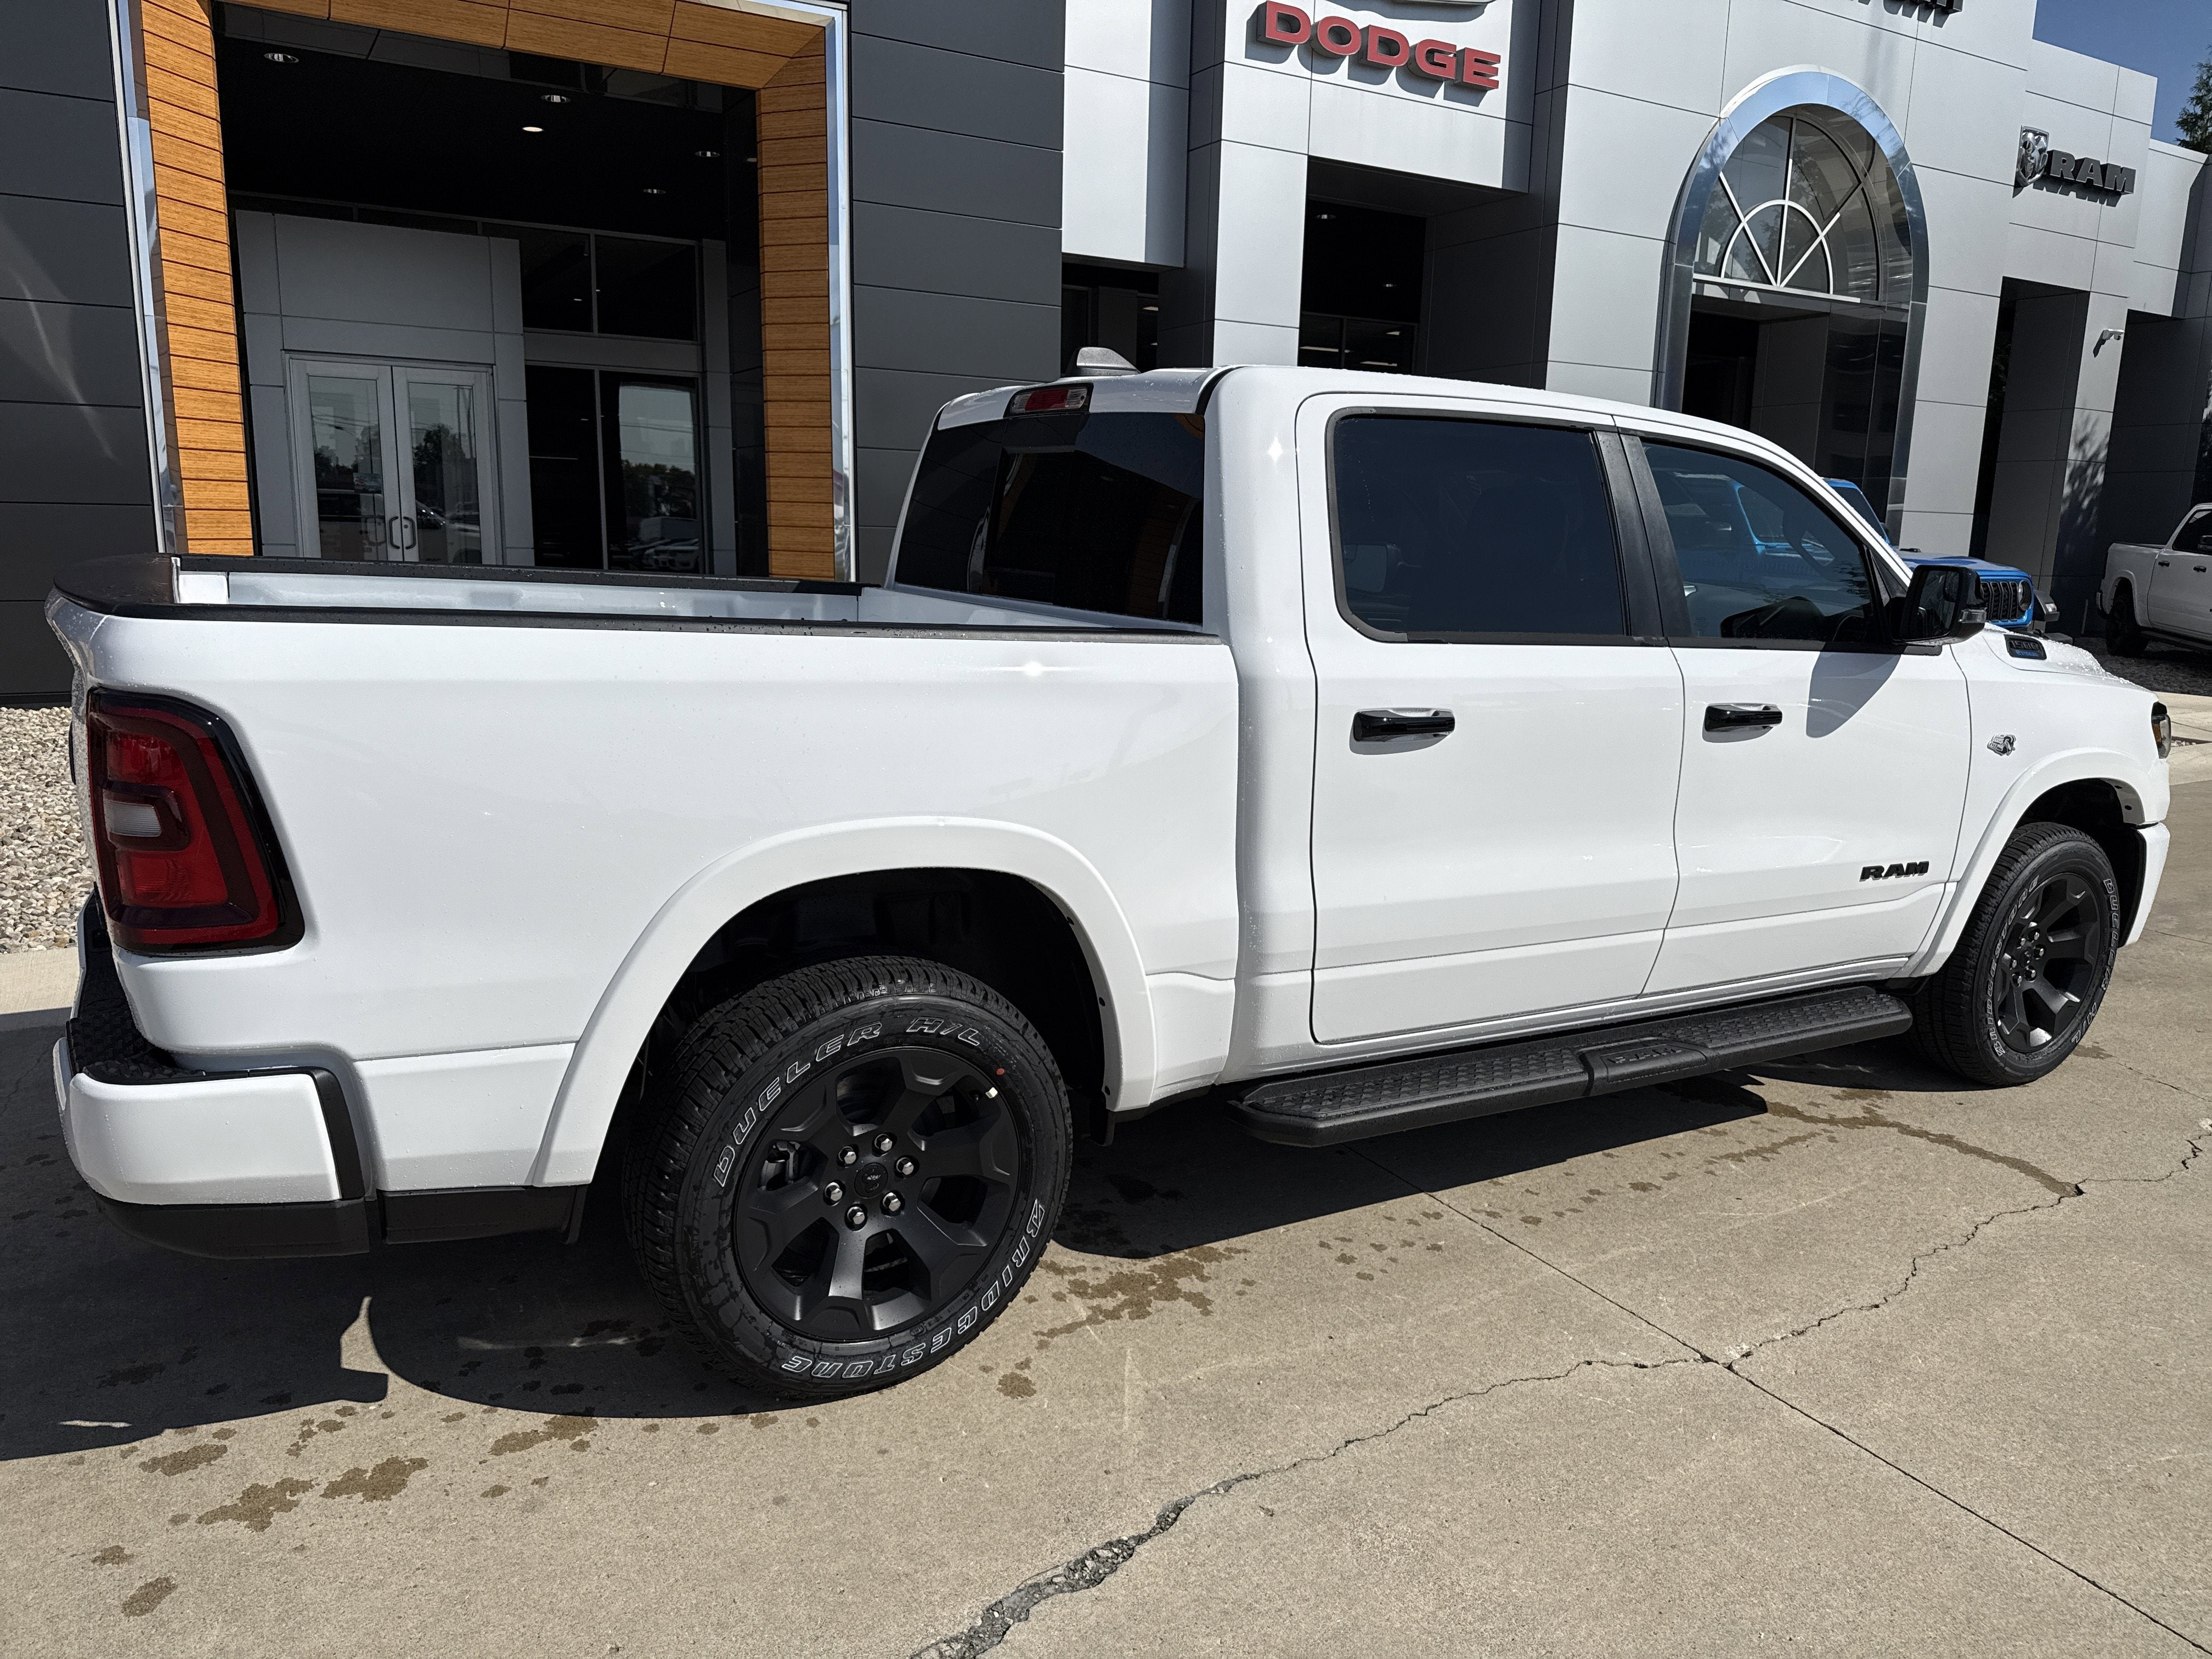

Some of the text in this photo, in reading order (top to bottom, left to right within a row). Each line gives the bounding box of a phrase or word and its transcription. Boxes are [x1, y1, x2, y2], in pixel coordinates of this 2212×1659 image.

[1264, 1, 1501, 89] DODGE
[2050, 149, 2137, 194] RAM
[1859, 861, 1929, 882] RAM
[713, 1020, 882, 1188] DUELER
[906, 1017, 980, 1046] H/L
[781, 1198, 1045, 1379] BRIDGESTONE
